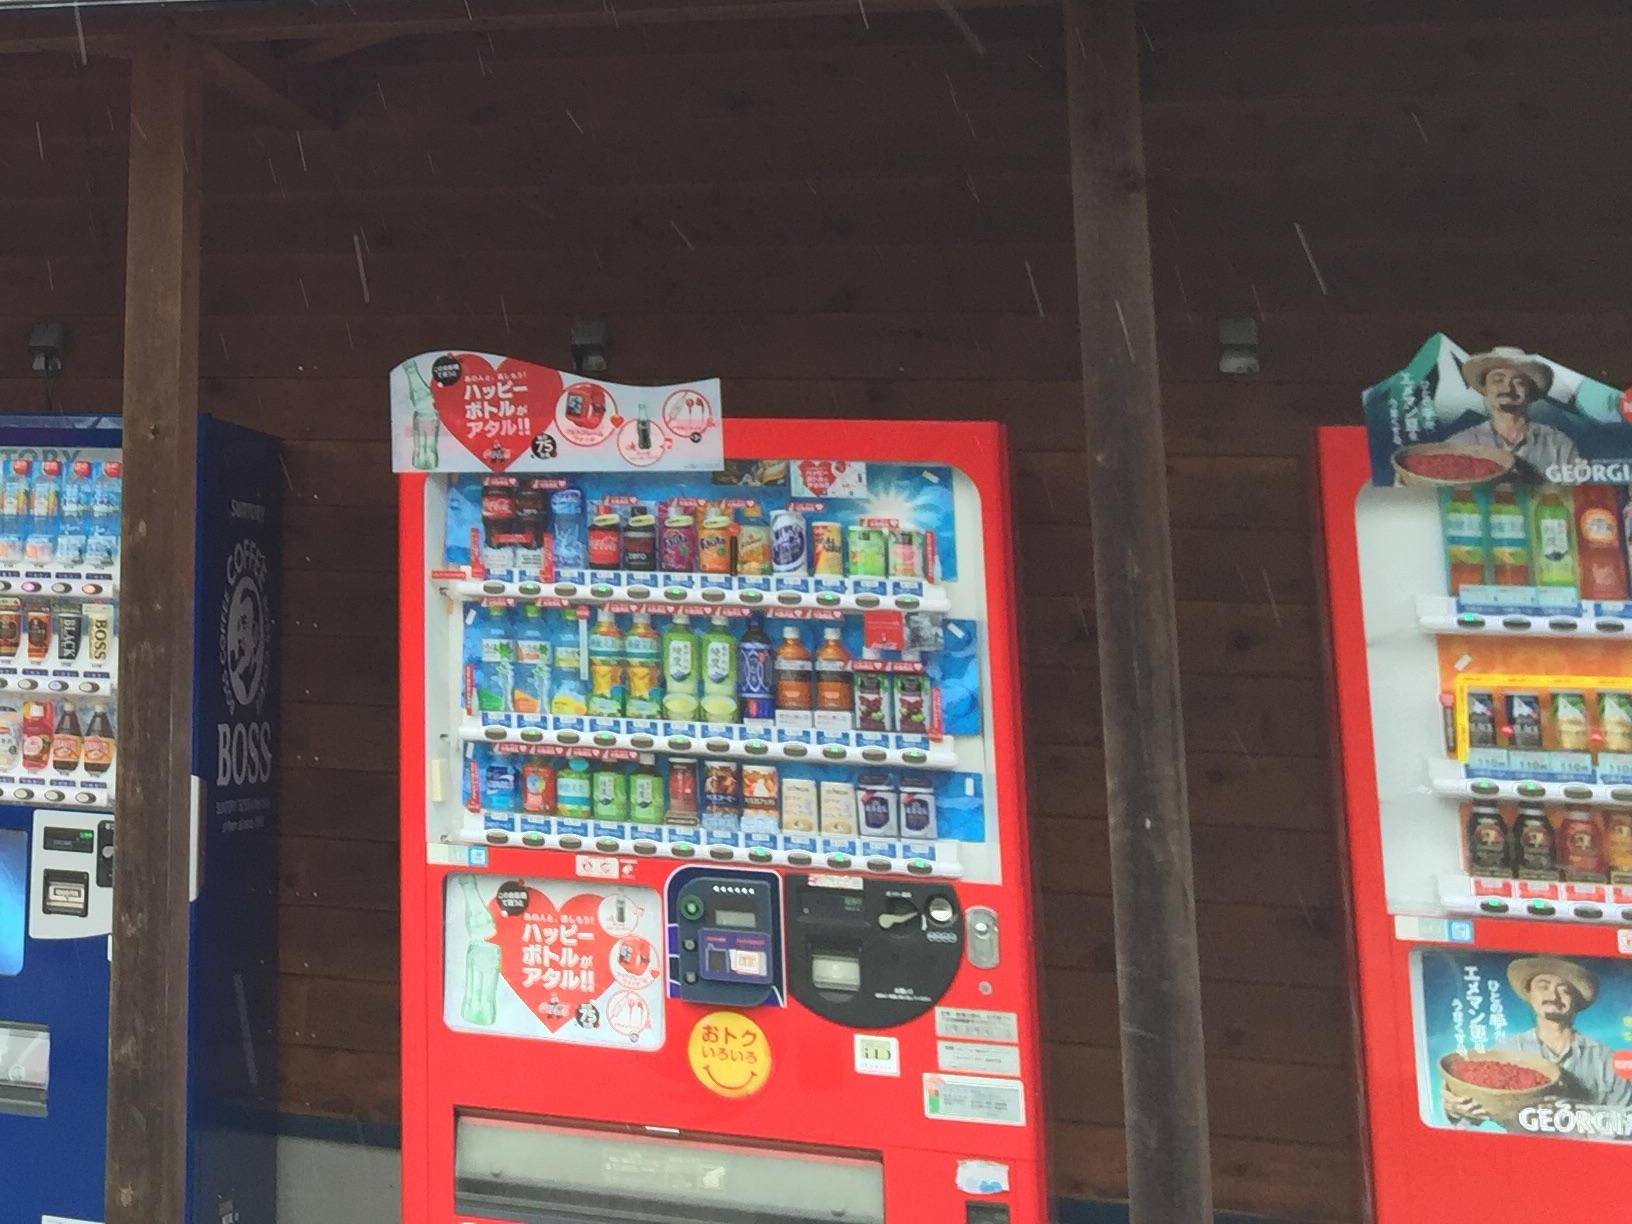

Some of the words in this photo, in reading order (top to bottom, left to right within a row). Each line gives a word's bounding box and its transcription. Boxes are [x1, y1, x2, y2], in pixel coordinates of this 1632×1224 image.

[464, 381, 528, 401] ハッピー
[465, 400, 528, 419] ボトルが
[63, 618, 77, 657] BLACK
[94, 618, 107, 660] BOSS
[216, 722, 273, 786] BOSS
[521, 923, 595, 946] ハッピー
[521, 944, 594, 968] ボトルが
[521, 966, 595, 993] アタル!!
[701, 1024, 757, 1045] おトク
[701, 1046, 758, 1065] いろいろ
